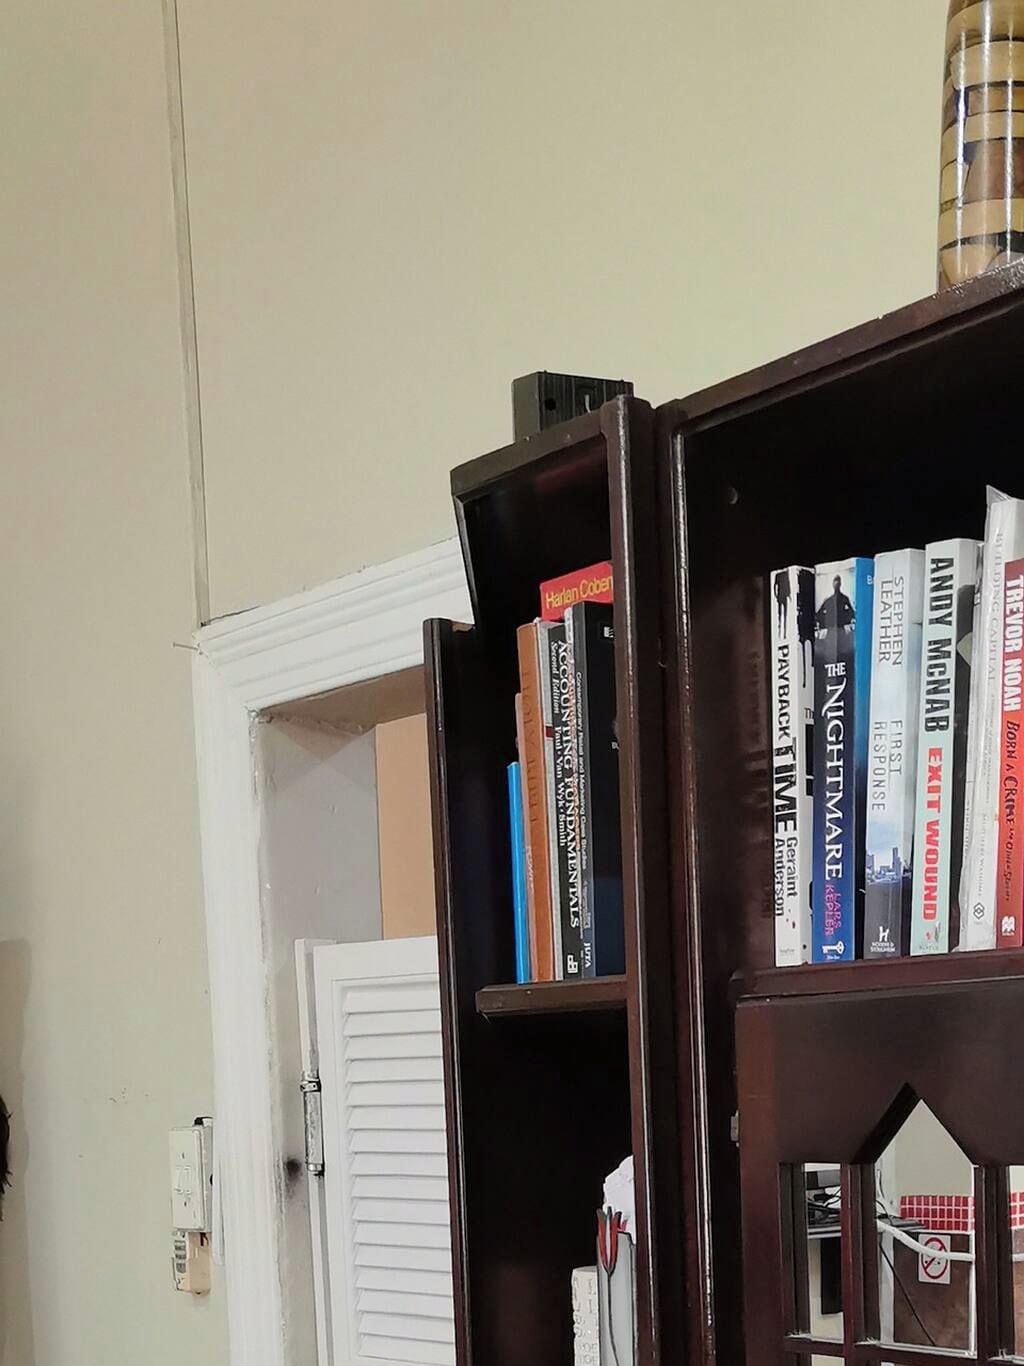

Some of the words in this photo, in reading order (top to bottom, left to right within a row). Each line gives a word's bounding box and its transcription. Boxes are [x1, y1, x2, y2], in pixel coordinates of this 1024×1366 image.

[545, 586, 578, 609] Harlan
[879, 580, 893, 663] LEATHER
[892, 575, 905, 666] STEPHEN
[928, 557, 954, 626] ANDY
[1004, 574, 1024, 653] TREVOR
[551, 641, 560, 675] Second
[824, 662, 846, 677] THE
[1003, 658, 1022, 712] NOAH
[552, 678, 561, 713] Edition
[558, 640, 573, 770] ACCOUNTING
[778, 644, 791, 740] PAYBACK
[872, 721, 887, 812] RESPONSE
[889, 719, 903, 775] FIRST
[1006, 720, 1020, 759] BORN
[556, 781, 566, 808] Wyk
[774, 738, 798, 833] TIME
[821, 678, 846, 881] NIGHTMARE
[926, 747, 944, 813] EXIT
[1003, 775, 1018, 827] CRIME
[558, 814, 567, 847] Smith
[563, 777, 580, 928] FUNDAMENTALS
[774, 838, 785, 916] Anderson
[786, 837, 798, 898] Geraint
[922, 819, 941, 922] WOUND
[584, 943, 592, 968] JUTA
